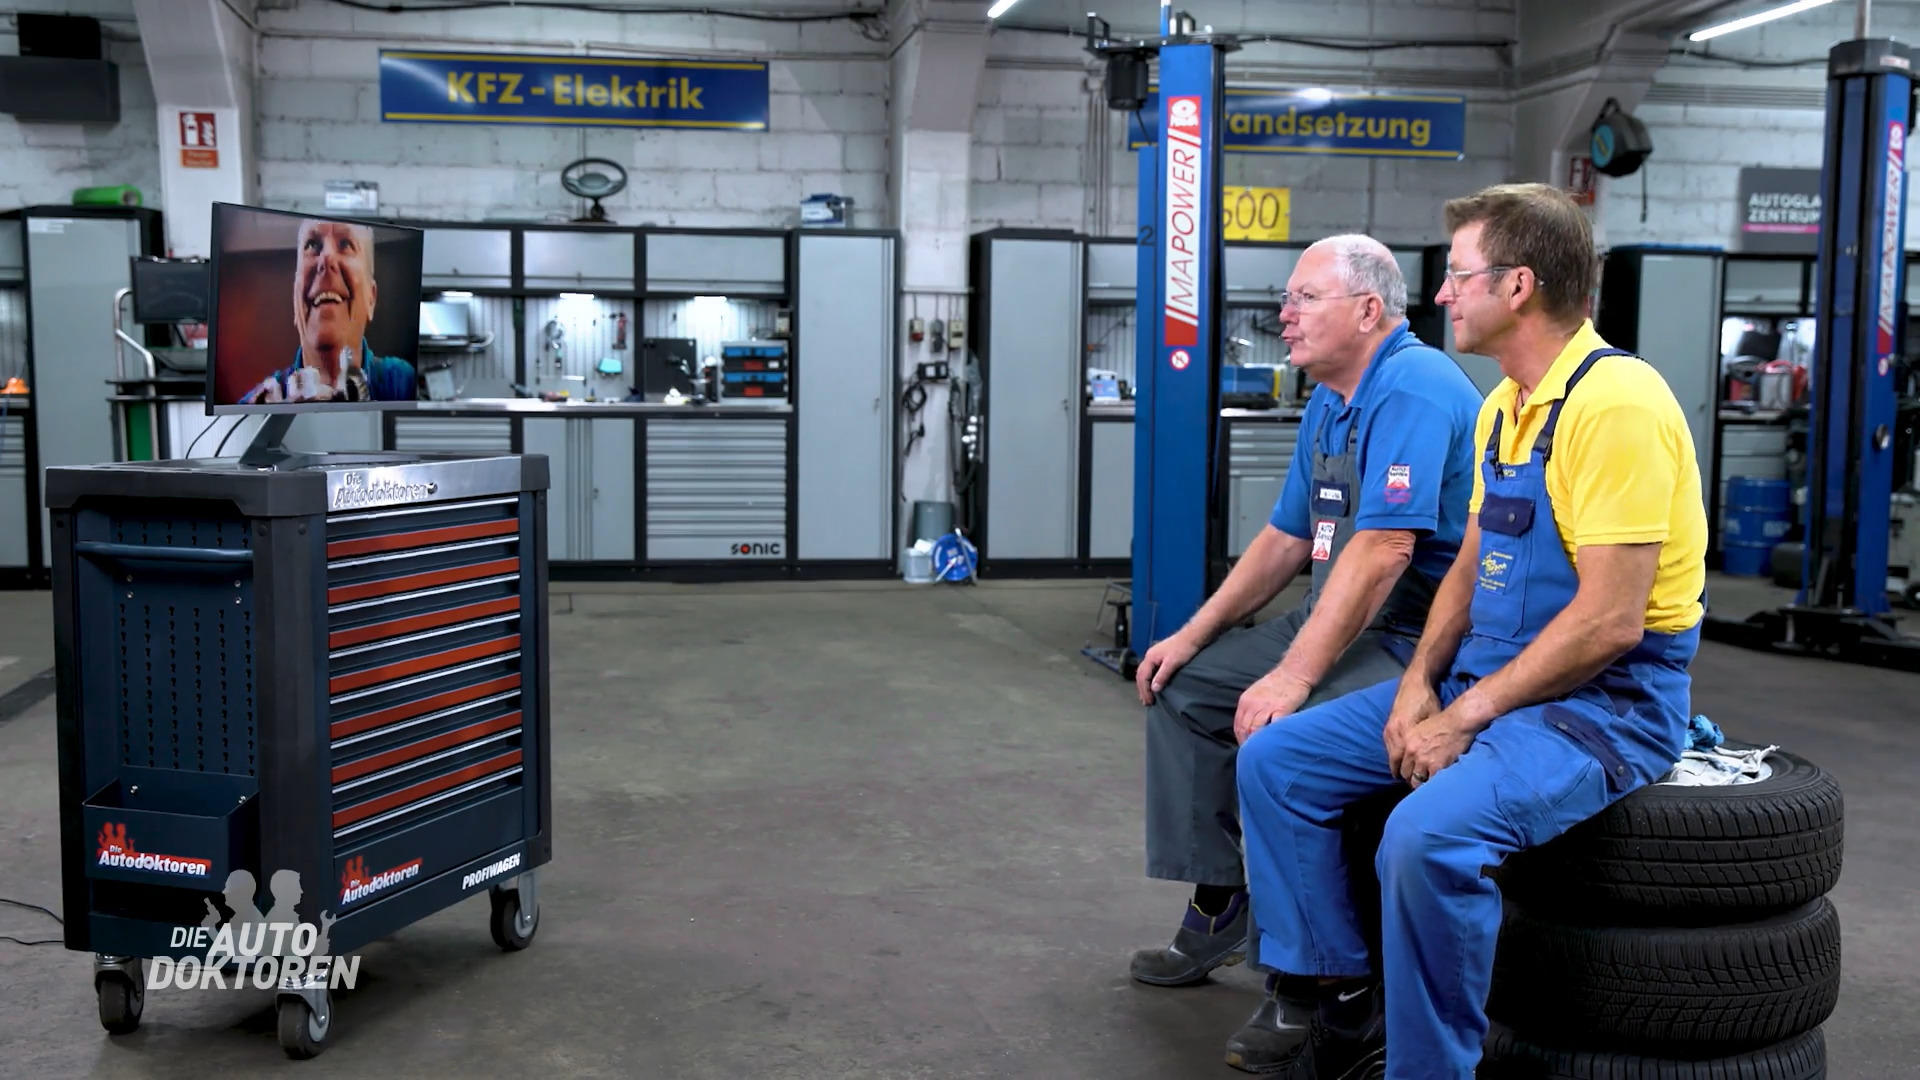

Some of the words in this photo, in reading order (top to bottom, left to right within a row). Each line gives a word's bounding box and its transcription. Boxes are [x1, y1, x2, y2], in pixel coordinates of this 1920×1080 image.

[447, 72, 524, 104] KFZ
[553, 75, 704, 109] Elektrik
[1224, 107, 1430, 146] andsetzung
[1171, 148, 1196, 308] MAPOWER
[99, 851, 206, 876] Autodoktoren
[462, 852, 521, 890] PROFIWAGEN
[342, 863, 420, 905] Autodoktoren
